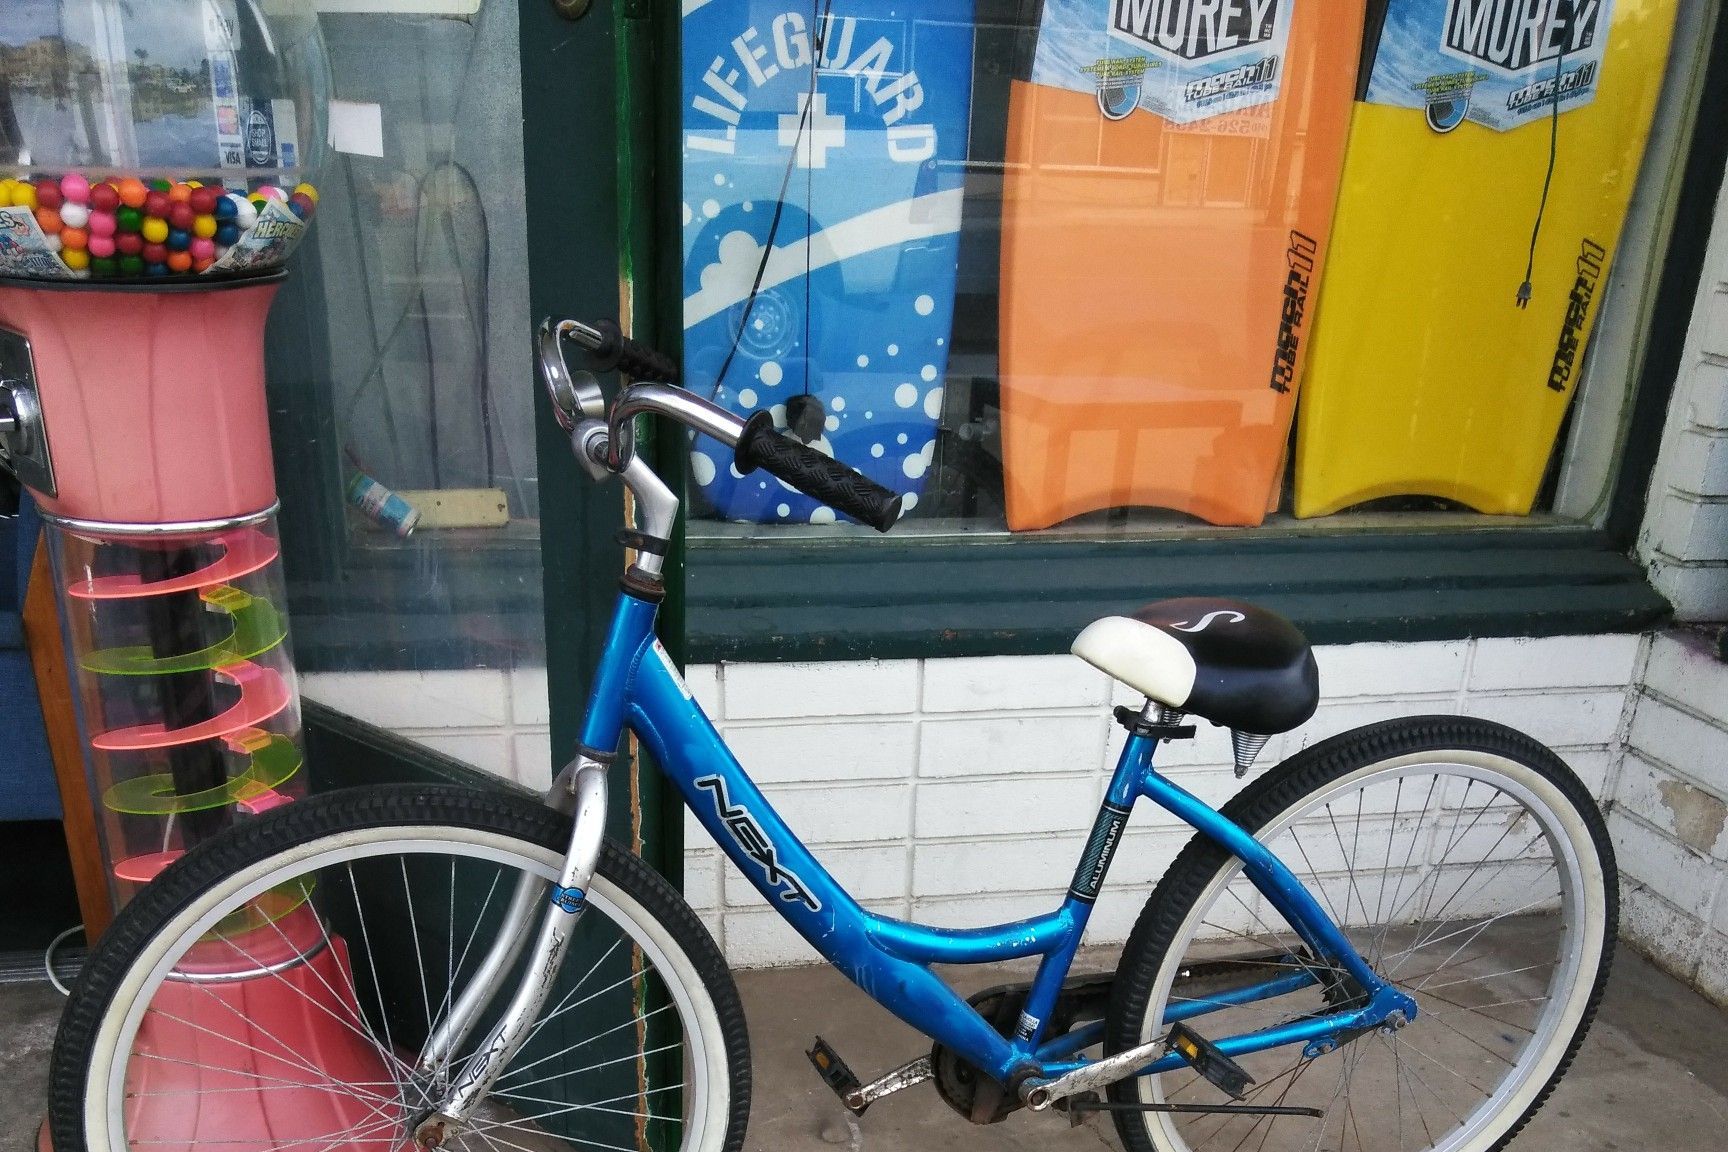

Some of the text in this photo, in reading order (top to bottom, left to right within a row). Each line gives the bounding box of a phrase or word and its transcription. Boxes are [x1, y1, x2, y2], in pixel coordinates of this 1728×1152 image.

[1119, 0, 1270, 57] MOREY
[1452, 0, 1597, 68] MOREY
[687, 12, 938, 163] LIFEGUARD
[1187, 83, 1220, 101] TUBE
[1225, 78, 1252, 91] RAIL
[224, 151, 241, 165] VISA
[1282, 275, 1309, 394] TUBE RAIL
[694, 774, 822, 912] NEXT
[1090, 820, 1121, 889] ALUMINUM
[457, 1023, 508, 1099] NEXT
